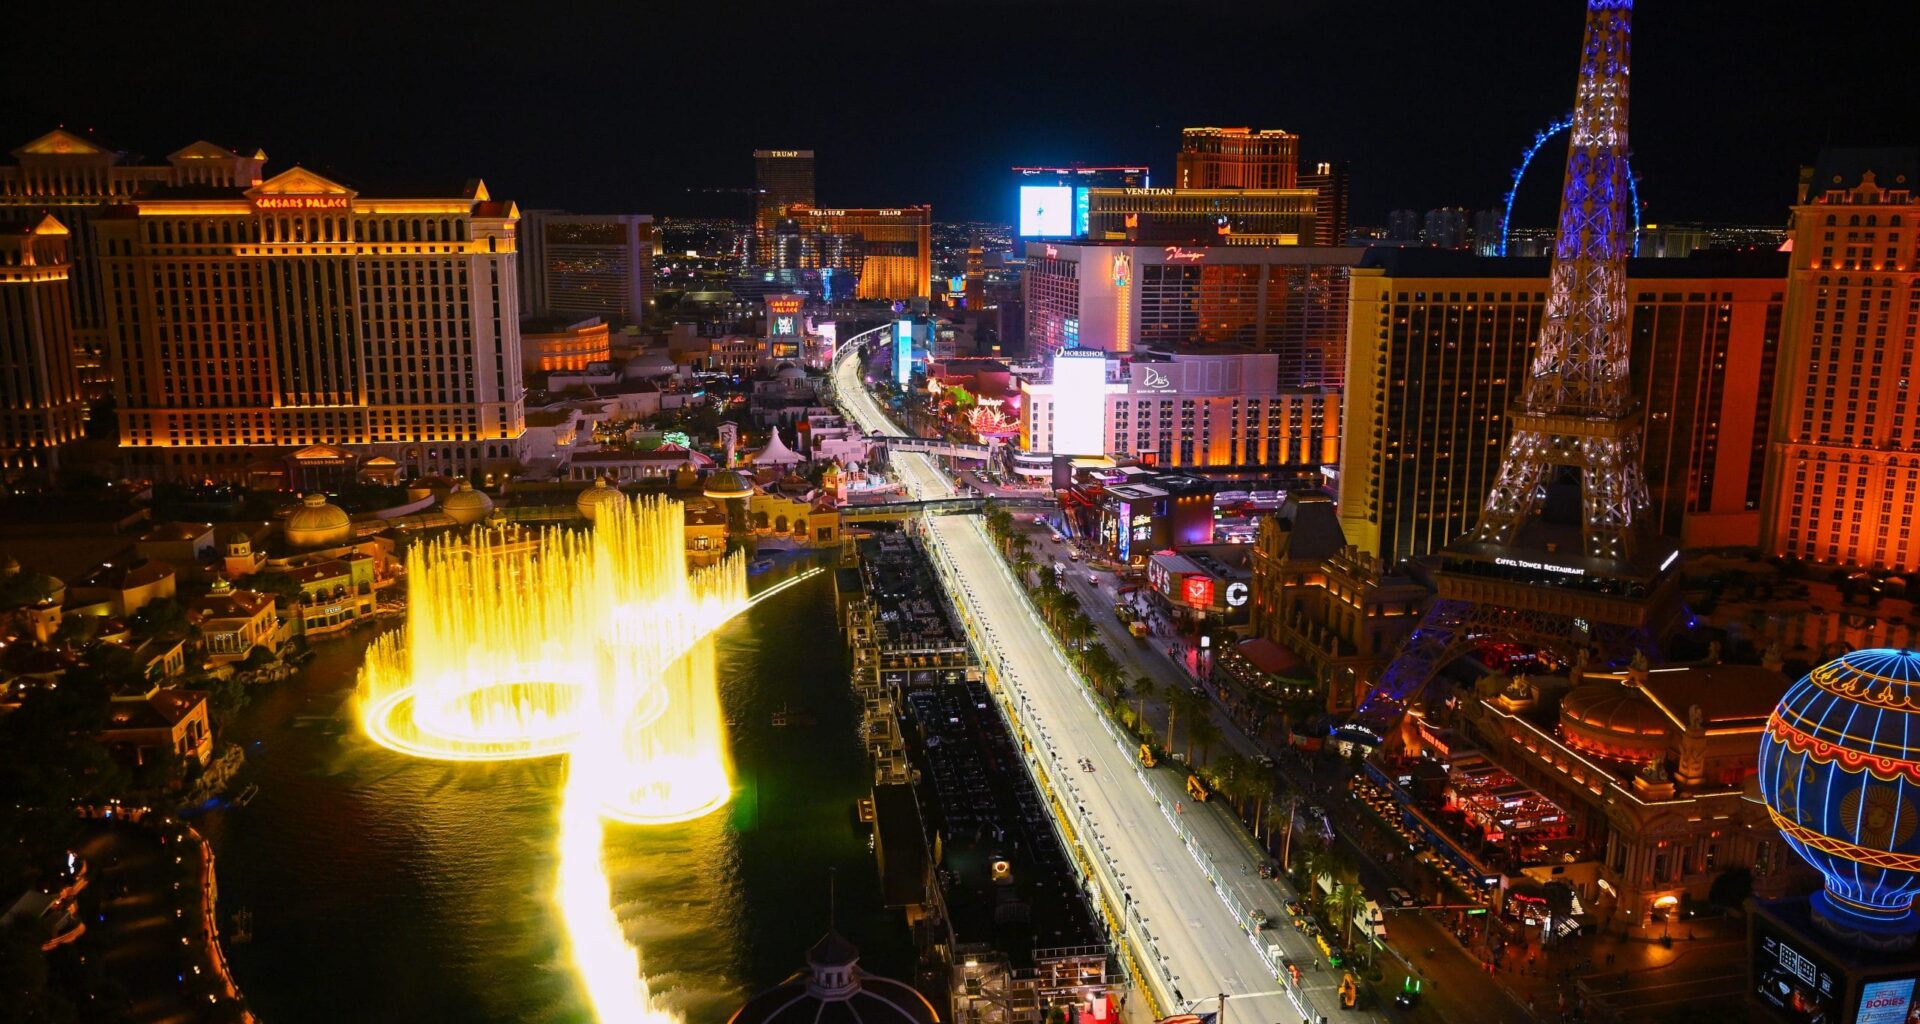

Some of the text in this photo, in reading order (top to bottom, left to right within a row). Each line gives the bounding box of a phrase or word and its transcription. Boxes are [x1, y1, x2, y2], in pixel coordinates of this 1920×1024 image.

[256, 198, 347, 208] CAESARS PALACE
[1165, 247, 1205, 260] Flamingo
[1495, 557, 1585, 575] EIFFEL TOWER RESTAURANT
[1148, 559, 1170, 596] CVS
[1226, 582, 1248, 606] C
[1866, 997, 1905, 1009] BODIES
